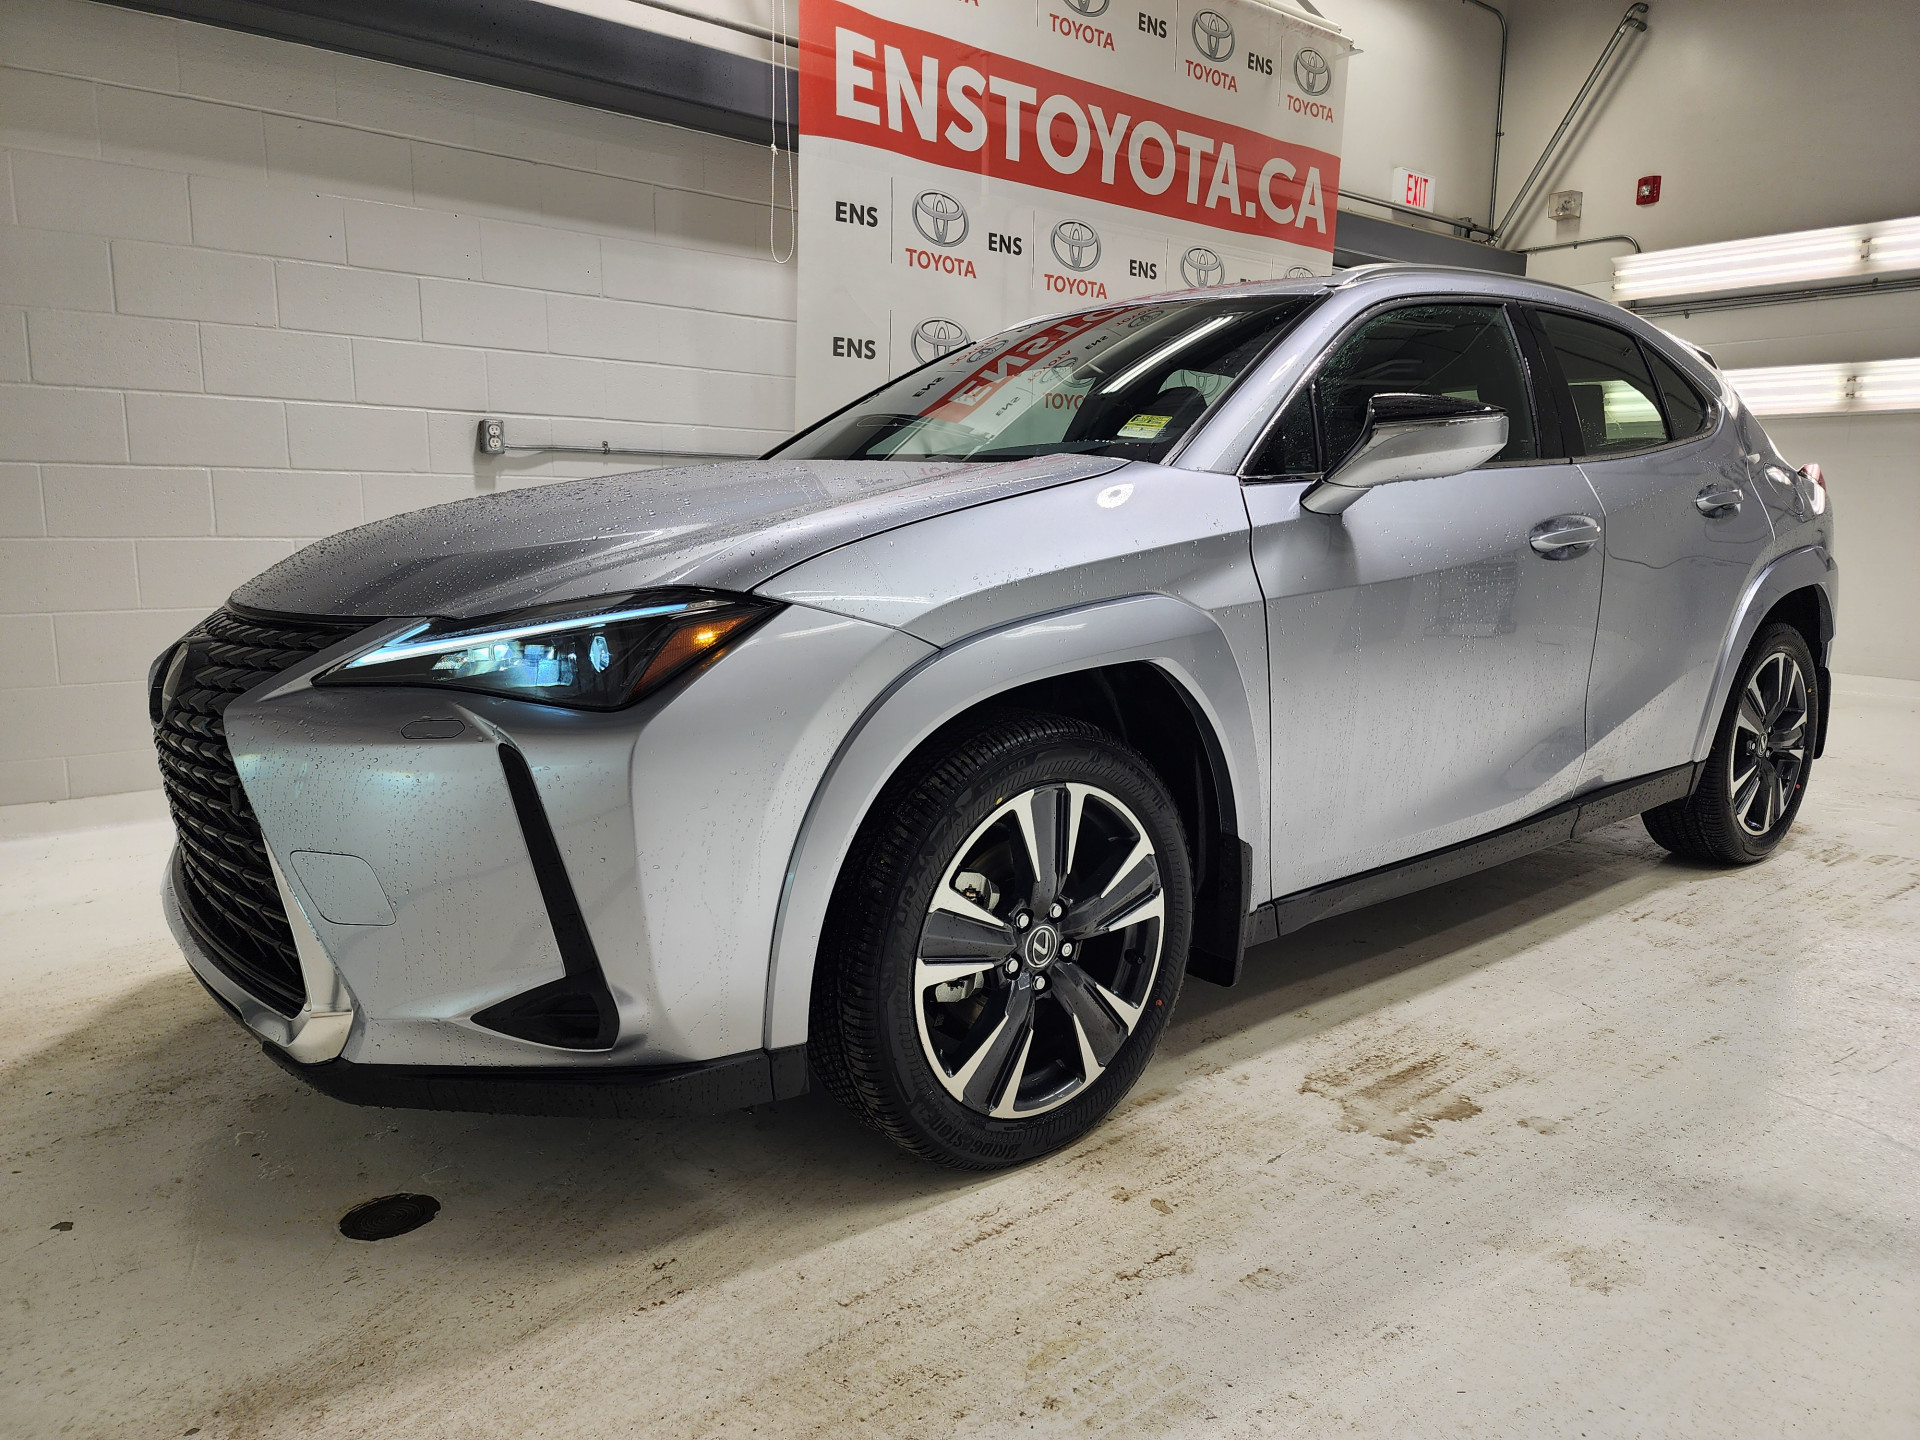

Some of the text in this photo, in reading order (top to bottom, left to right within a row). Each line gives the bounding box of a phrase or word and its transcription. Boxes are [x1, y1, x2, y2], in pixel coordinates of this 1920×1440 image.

[1049, 13, 1115, 51] TOYOTA
[1138, 12, 1167, 38] ENS
[1185, 59, 1237, 93] TOYOTA
[1248, 52, 1273, 75] ENS
[1287, 95, 1334, 123] TOYOTA
[835, 27, 1327, 235] ENSTOYOTA.CA
[1405, 173, 1429, 209] EXIT
[835, 201, 878, 227] ENS
[988, 232, 1022, 256] ENS
[905, 248, 977, 279] TOYOTA
[1129, 259, 1157, 280] ENS
[1044, 273, 1107, 300] TOYOTA
[833, 337, 876, 360] ENS
